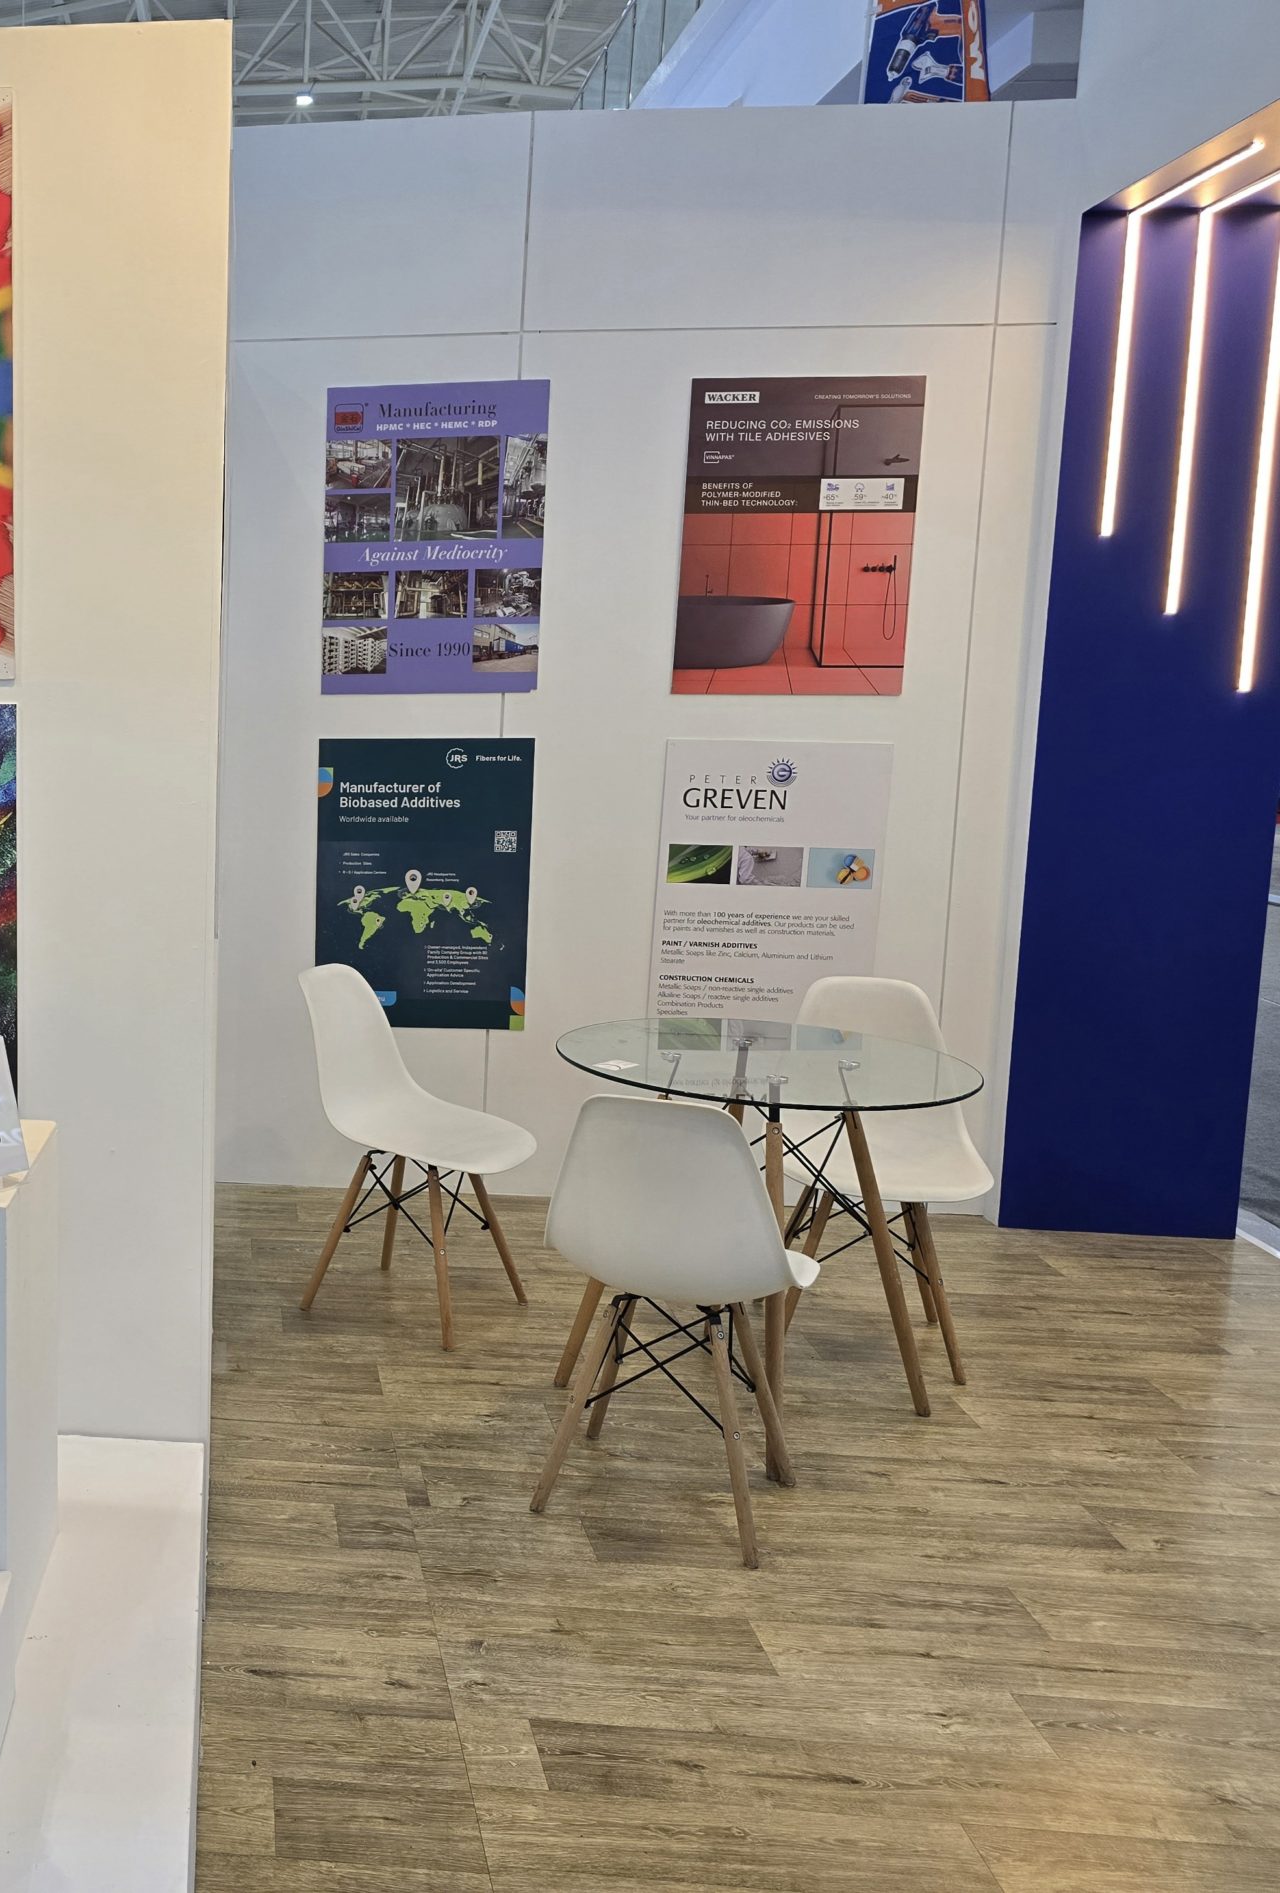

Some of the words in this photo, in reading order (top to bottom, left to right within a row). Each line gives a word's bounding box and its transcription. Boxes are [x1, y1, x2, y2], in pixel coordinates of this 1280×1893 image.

[708, 393, 757, 402] WACKER
[378, 401, 497, 418] Manufacturing
[377, 423, 403, 431] HPMC
[413, 422, 431, 431] HEC
[441, 421, 468, 430] HEMC
[478, 420, 498, 429] RDP
[706, 420, 766, 429] REDUCING
[795, 419, 859, 429] EMISSIONS
[706, 432, 734, 442] WITH
[739, 432, 761, 441] TILE
[766, 431, 830, 441] ADHESIVES
[703, 482, 740, 490] BENEFITS
[743, 482, 753, 490] OF
[742, 499, 798, 507] TECHNOLOGY:
[359, 546, 419, 566] Against
[423, 545, 507, 562] Mediocrity
[388, 644, 431, 658] Since
[437, 642, 470, 656] 1990
[450, 754, 467, 763] JRS
[690, 775, 757, 784] PETER
[340, 782, 425, 793] Manufacturer
[428, 782, 441, 793] of
[340, 796, 397, 808] Biobased
[401, 796, 460, 808] Additives
[683, 788, 787, 810] GREVEN
[701, 814, 725, 823] partner
[727, 814, 737, 822] for
[738, 815, 784, 823] oleochemicals
[664, 909, 677, 917] With
[697, 910, 711, 918] than
[713, 911, 725, 919] 100
[747, 911, 753, 919] of
[755, 913, 790, 921] experience
[815, 915, 828, 923] your
[662, 940, 682, 948] PAINT
[689, 941, 719, 949] VARNISH
